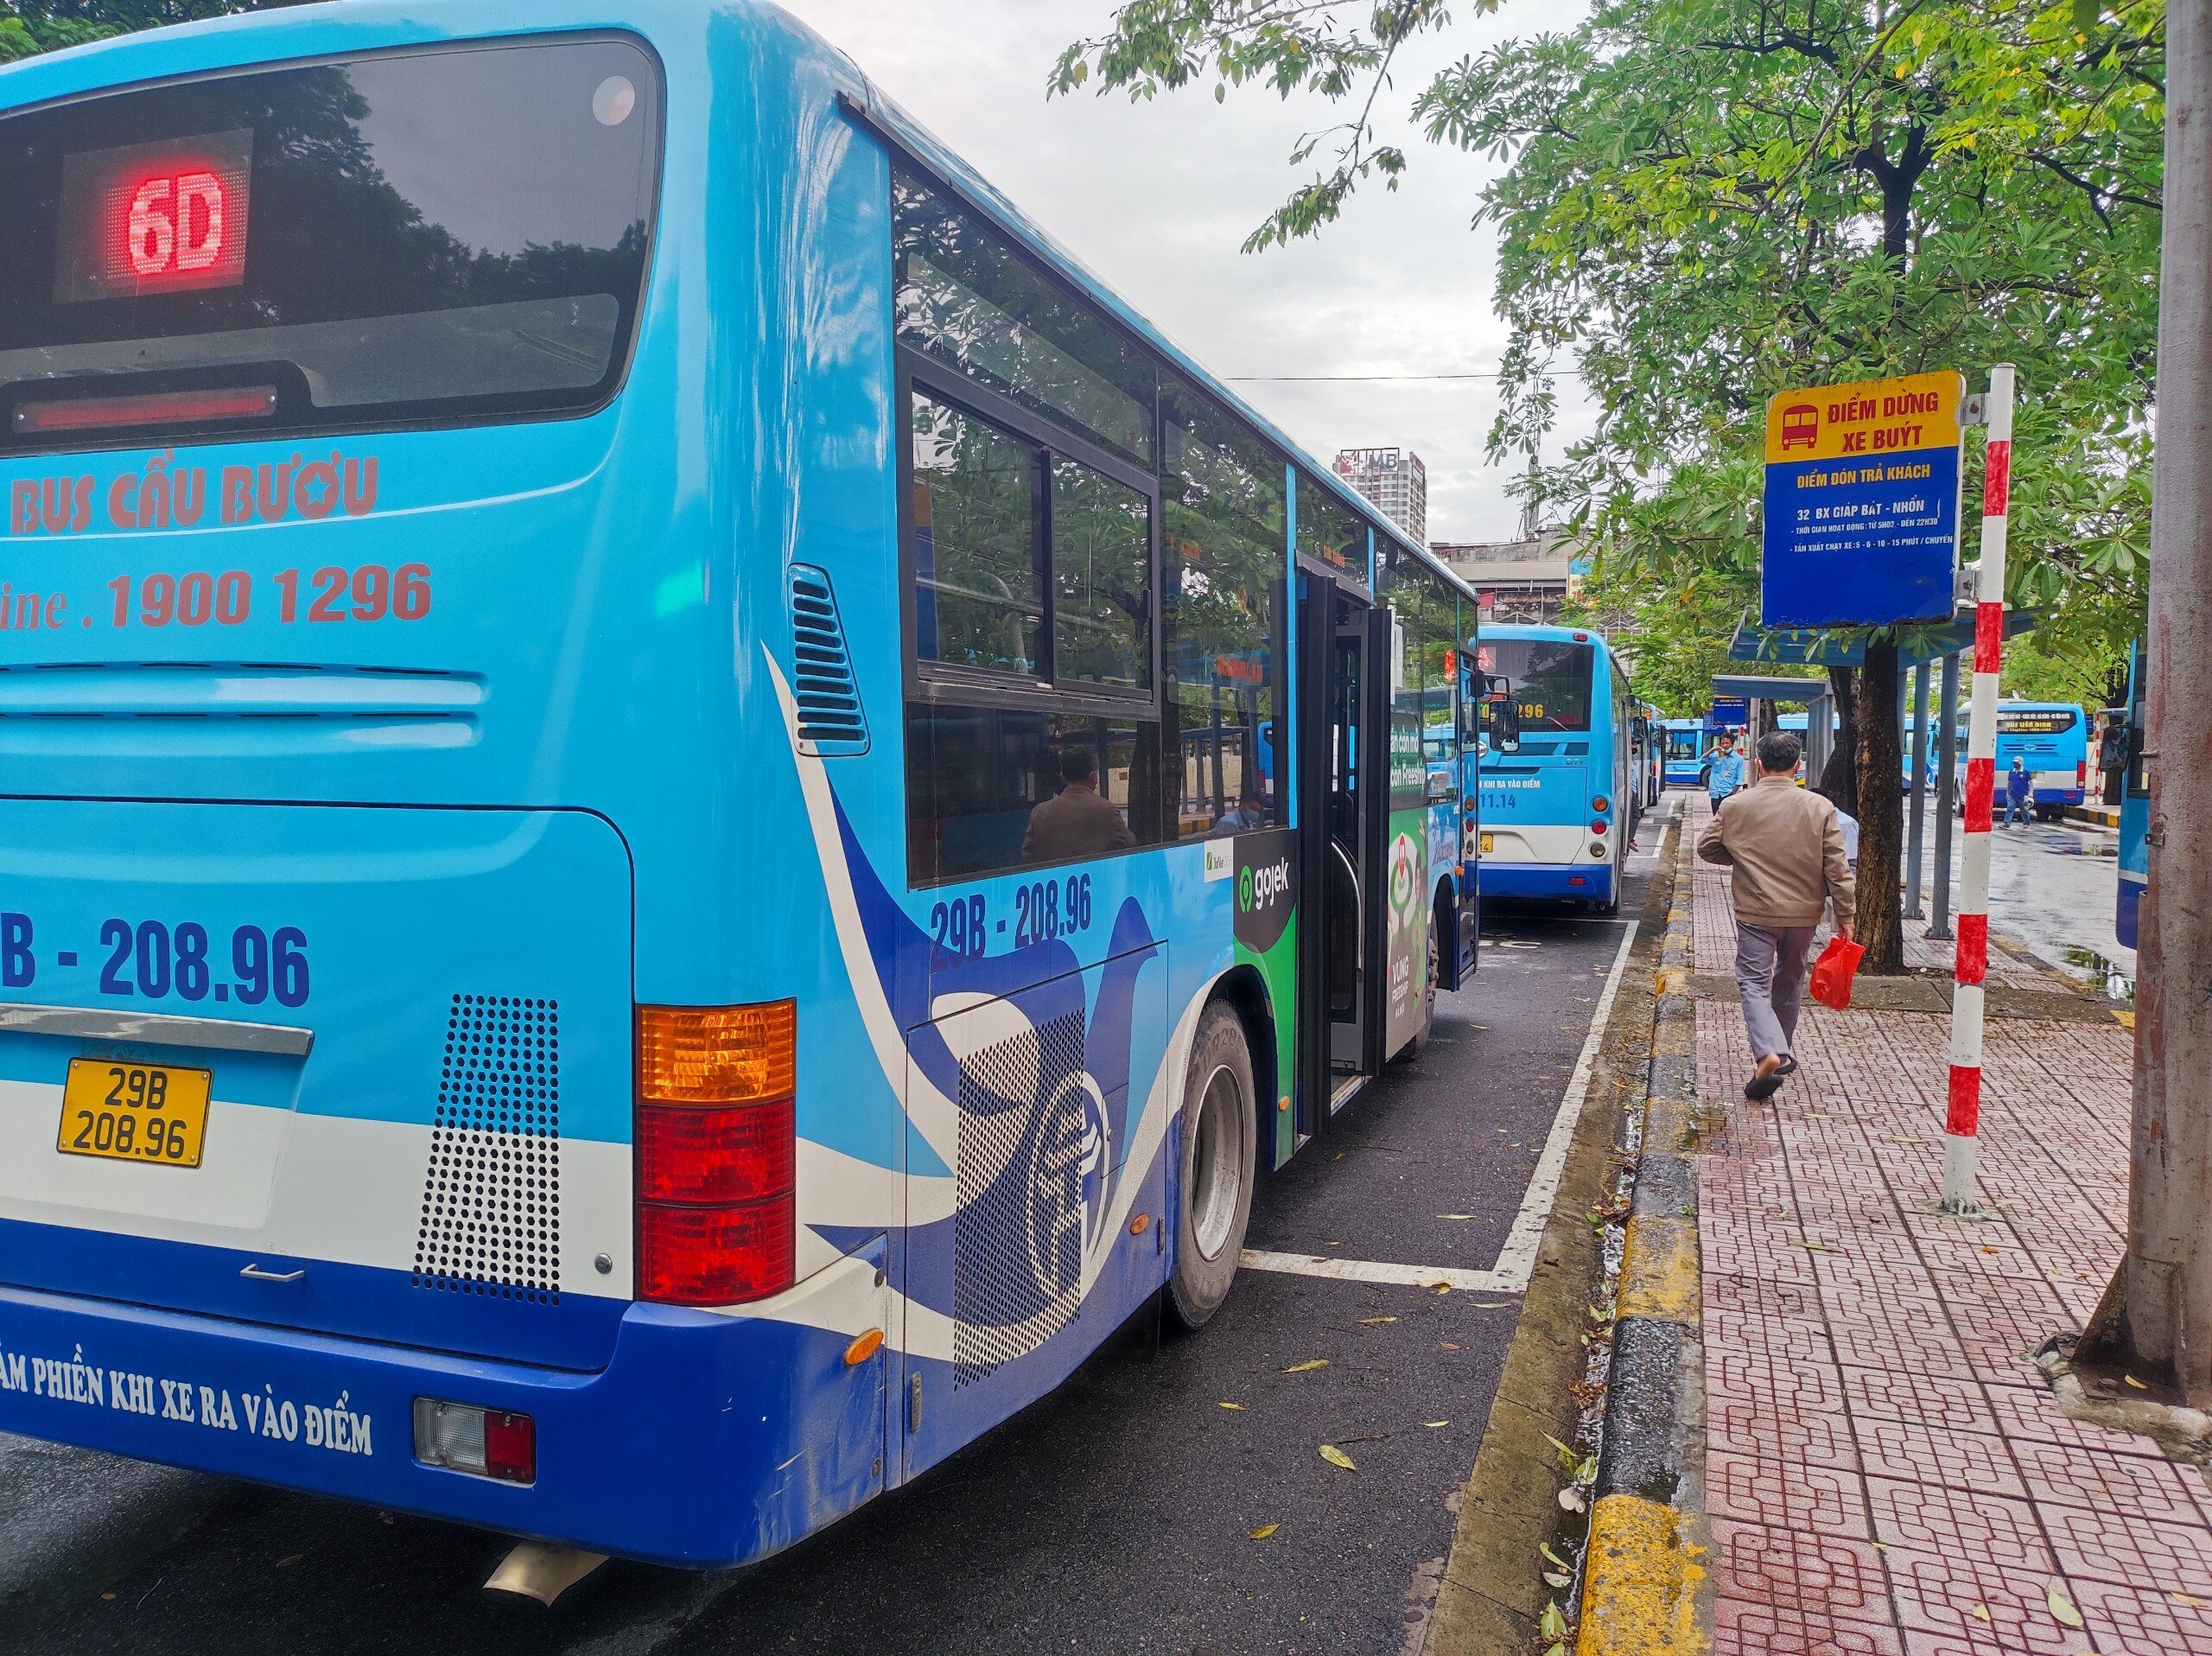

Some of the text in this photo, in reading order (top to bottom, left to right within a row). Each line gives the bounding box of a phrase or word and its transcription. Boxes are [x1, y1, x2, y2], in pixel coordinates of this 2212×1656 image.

[128, 173, 223, 275] 6D
[1827, 392, 1877, 424] ĐIỂM
[1884, 388, 1939, 417] DỪNG
[1842, 421, 1923, 452] XE BUÝT
[1366, 454, 1397, 468] MB
[1797, 462, 1930, 488] ĐIỂM ĐÓN TRẢ KHÁCH
[10, 448, 379, 535] BUS CẦU BƯƠU
[1797, 509, 1810, 520] 32
[1815, 507, 1830, 519] BX
[1833, 501, 1859, 518] GIÁP
[1892, 494, 1924, 513] NHỔN
[108, 570, 252, 627] 1900
[273, 563, 432, 624] 1296
[1484, 780, 1495, 788] KHI
[1497, 780, 1506, 788] RA
[1508, 779, 1521, 788] VÀO
[1255, 857, 1289, 910] gojek
[931, 893, 987, 974] 29B
[1014, 872, 1092, 949] 208.96
[99, 918, 310, 1008] 208.96
[105, 1067, 168, 1110] 29B
[73, 1111, 188, 1158] 208.96
[31, 1342, 104, 1406] PHIỀN
[109, 1370, 155, 1416] KHI
[160, 1379, 195, 1422] XE
[200, 1386, 238, 1431] RA
[241, 1383, 298, 1442] VÀO
[304, 1390, 373, 1455] ĐIỂM
